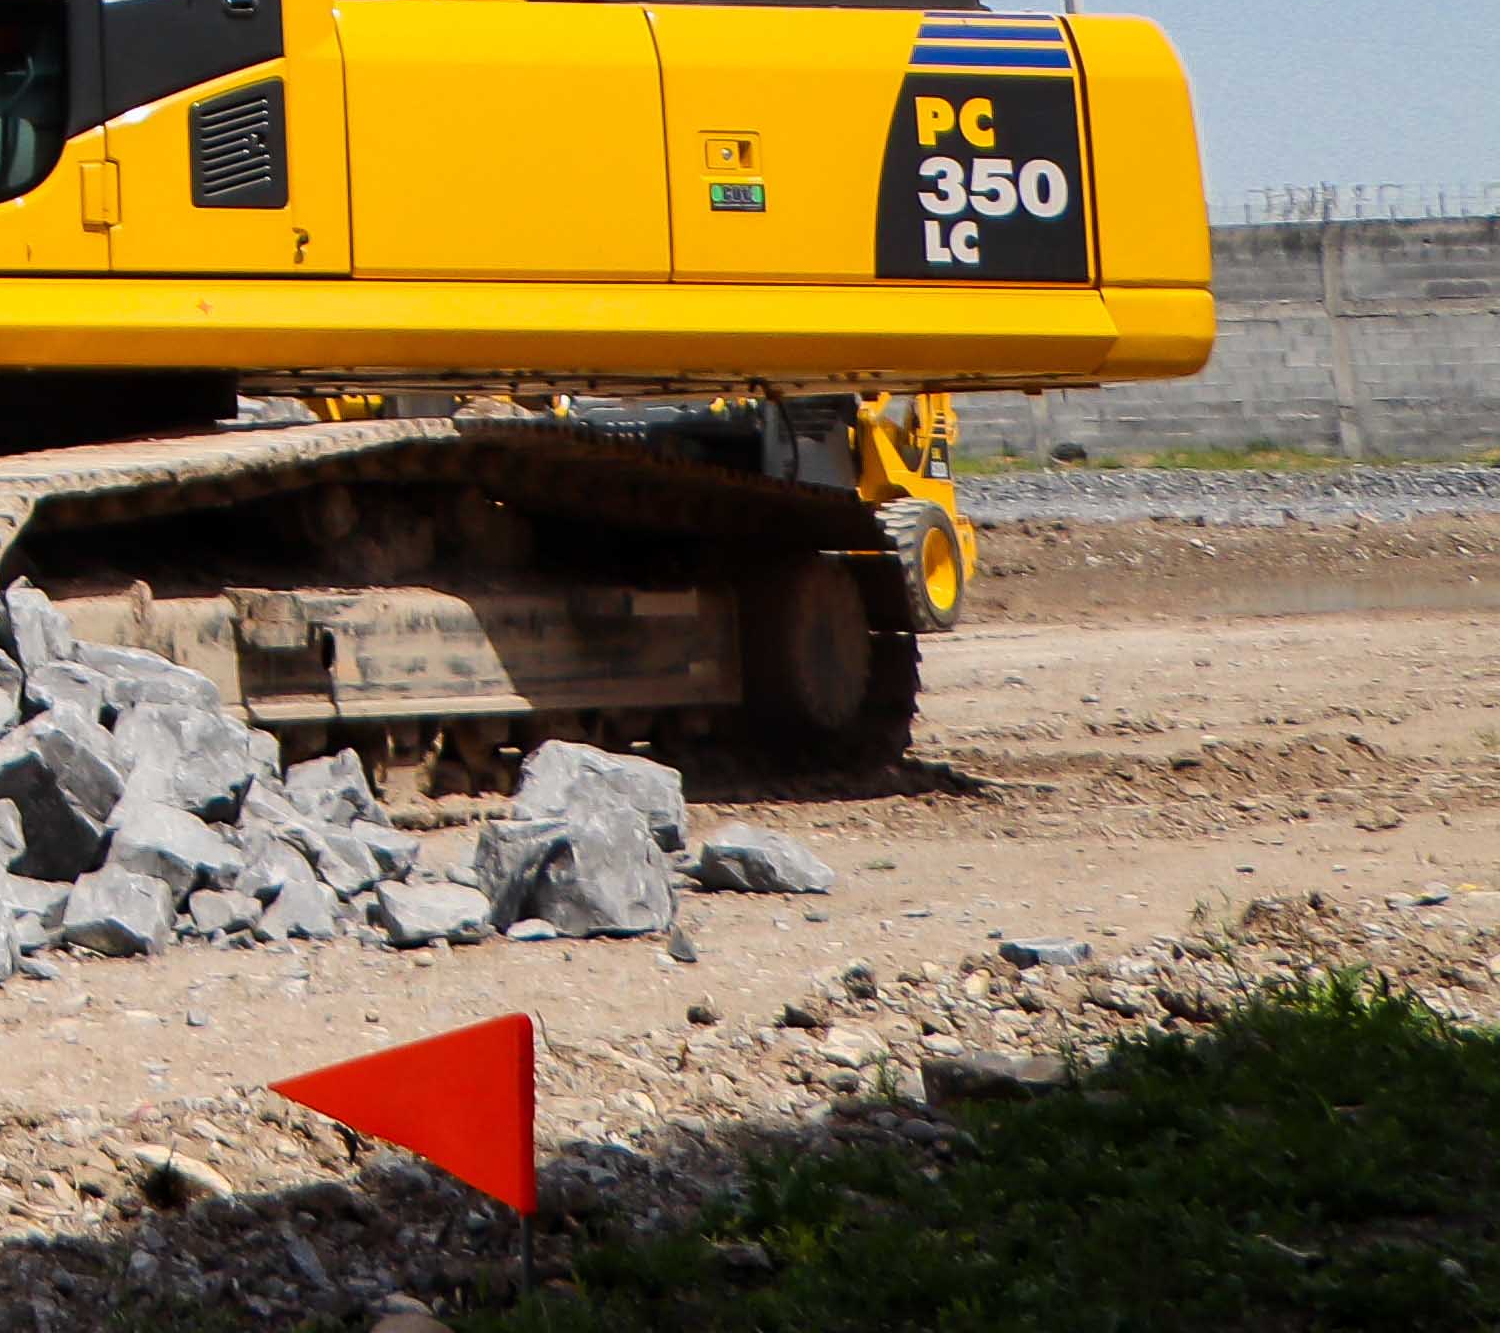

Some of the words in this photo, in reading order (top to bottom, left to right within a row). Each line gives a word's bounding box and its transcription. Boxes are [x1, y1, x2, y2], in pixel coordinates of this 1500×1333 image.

[915, 96, 995, 148] PC
[918, 156, 1069, 218] 350
[924, 220, 980, 263] LC
